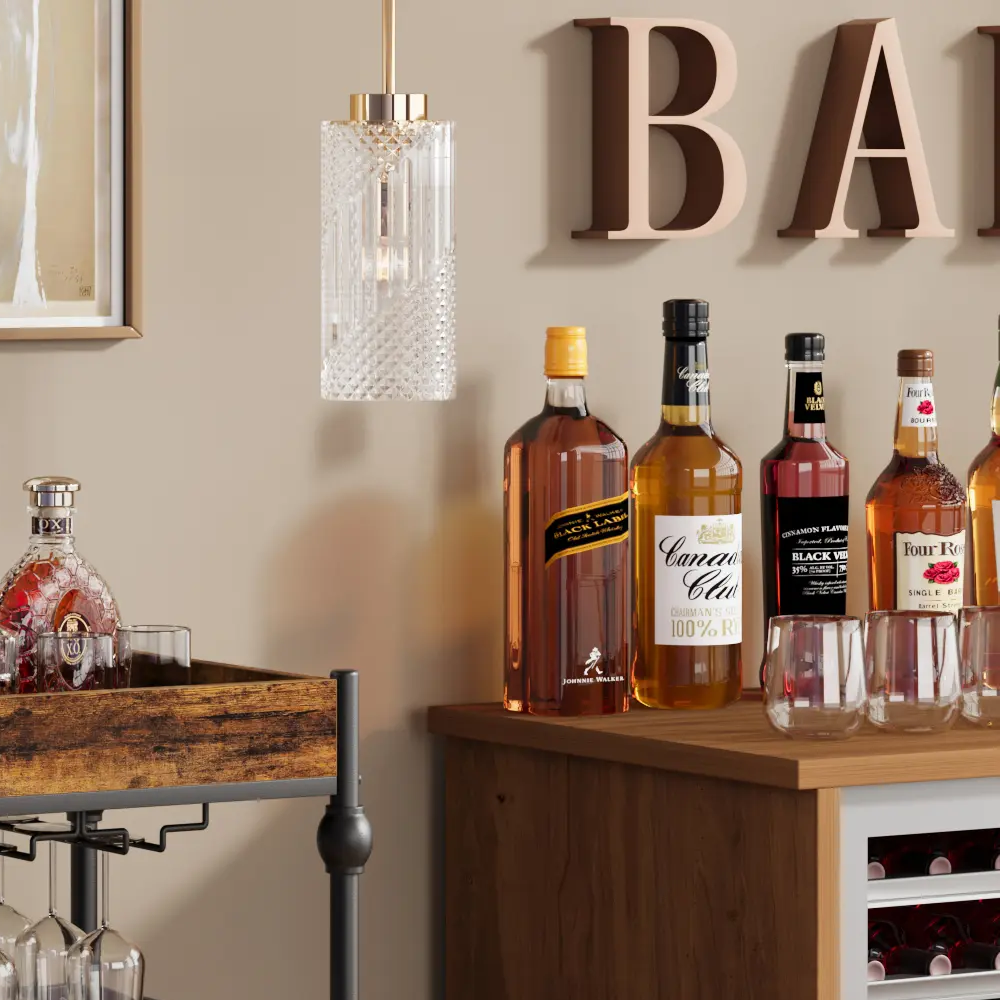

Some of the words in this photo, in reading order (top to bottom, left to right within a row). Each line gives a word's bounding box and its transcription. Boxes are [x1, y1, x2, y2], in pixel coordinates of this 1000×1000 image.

[571, 17, 1000, 239] BA
[553, 524, 592, 539] BLACK
[781, 526, 819, 539] CINNAMON
[903, 541, 938, 556] Four
[791, 551, 832, 562] BLACK
[908, 589, 941, 597] SINGLE
[671, 619, 718, 637] 100%
[595, 675, 625, 683] WALKER
